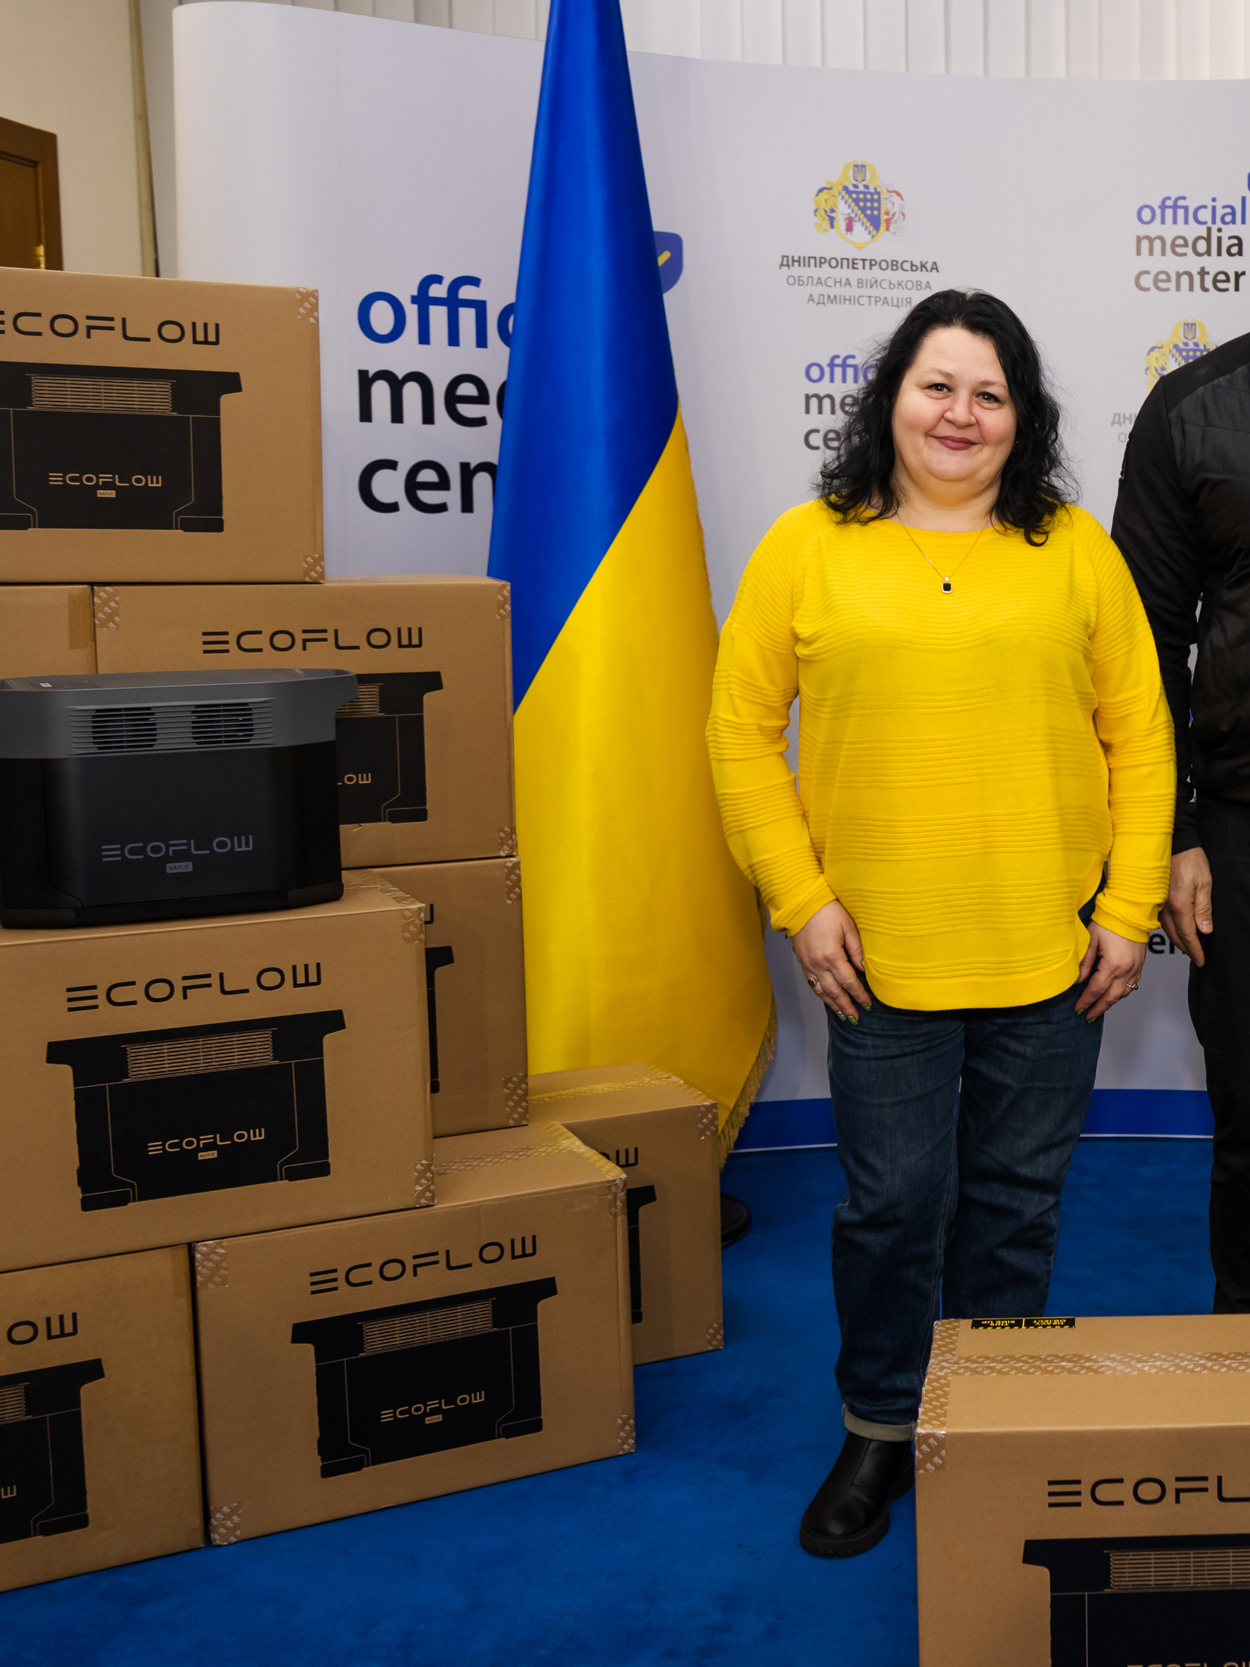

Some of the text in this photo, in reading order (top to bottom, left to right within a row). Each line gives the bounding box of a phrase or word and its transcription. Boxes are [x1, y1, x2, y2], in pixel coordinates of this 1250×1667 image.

[1136, 195, 1247, 226] official
[1135, 226, 1244, 257] media
[779, 254, 940, 273] ДНІПРОПЕТРОВСЬКА
[786, 275, 932, 291] ОБЛАСНА ВІЙСЬКОВА
[1134, 265, 1246, 292] center
[806, 293, 912, 309] АДМІНІСТРАЦІЯ
[0, 310, 220, 346] COFLOW
[48, 472, 162, 487] ECOFLOW
[202, 627, 424, 654] ECOFLOW
[101, 835, 253, 861] ECOFLOW
[167, 863, 191, 872] MAX
[66, 962, 322, 1012] ECOFLOW
[147, 1127, 265, 1155] ECOFLOW
[309, 1234, 538, 1295] ECOFLOW
[380, 1390, 485, 1422] ECOFLOW
